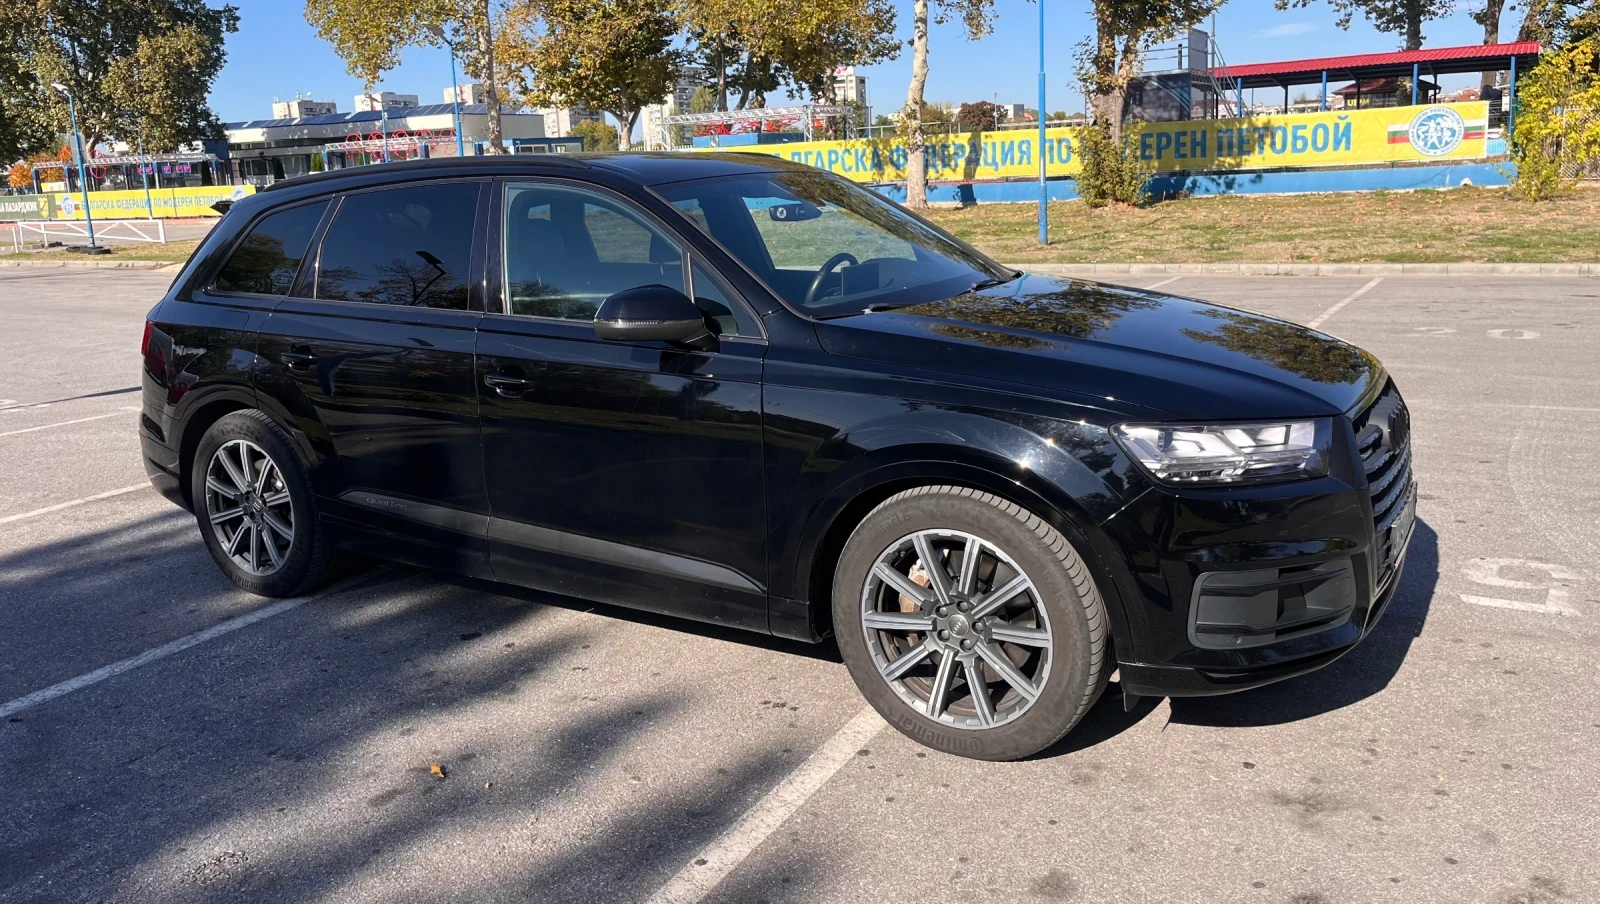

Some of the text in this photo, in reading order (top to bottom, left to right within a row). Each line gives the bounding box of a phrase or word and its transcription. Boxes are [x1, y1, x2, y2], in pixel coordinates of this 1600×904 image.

[773, 147, 884, 173] ЛГАРСКА
[889, 139, 1032, 173] ФДЕРАЦИЯ
[1216, 115, 1352, 157] ПЕТОБОЙ
[81, 200, 115, 211] БЛГАРСКА
[154, 198, 162, 208] ПО
[898, 711, 985, 754] Continental
